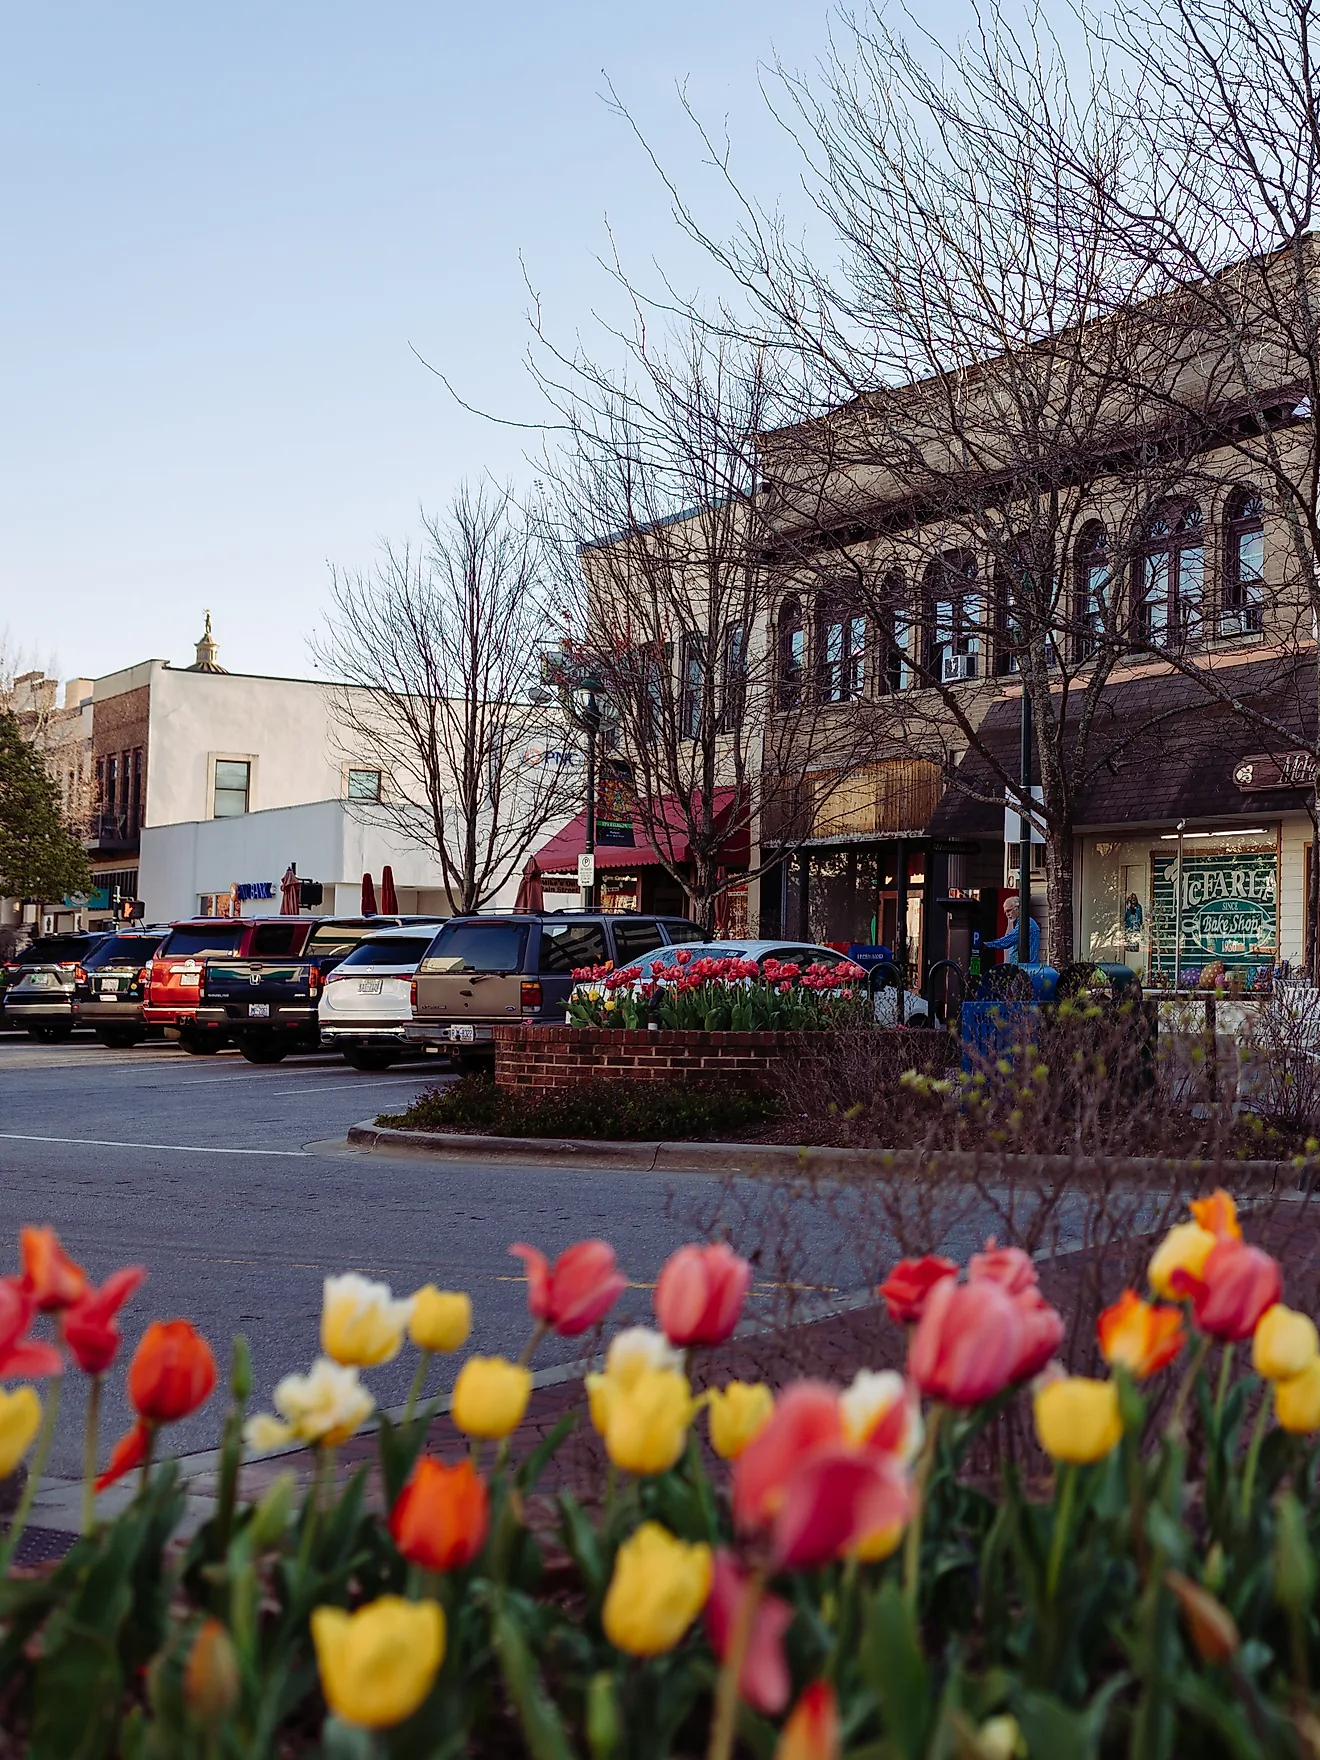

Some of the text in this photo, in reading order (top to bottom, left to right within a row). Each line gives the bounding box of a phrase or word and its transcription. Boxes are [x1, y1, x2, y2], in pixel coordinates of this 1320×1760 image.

[545, 751, 585, 766] PNC
[1222, 902, 1239, 911] SINCE
[1203, 913, 1261, 934] Bake Shop
